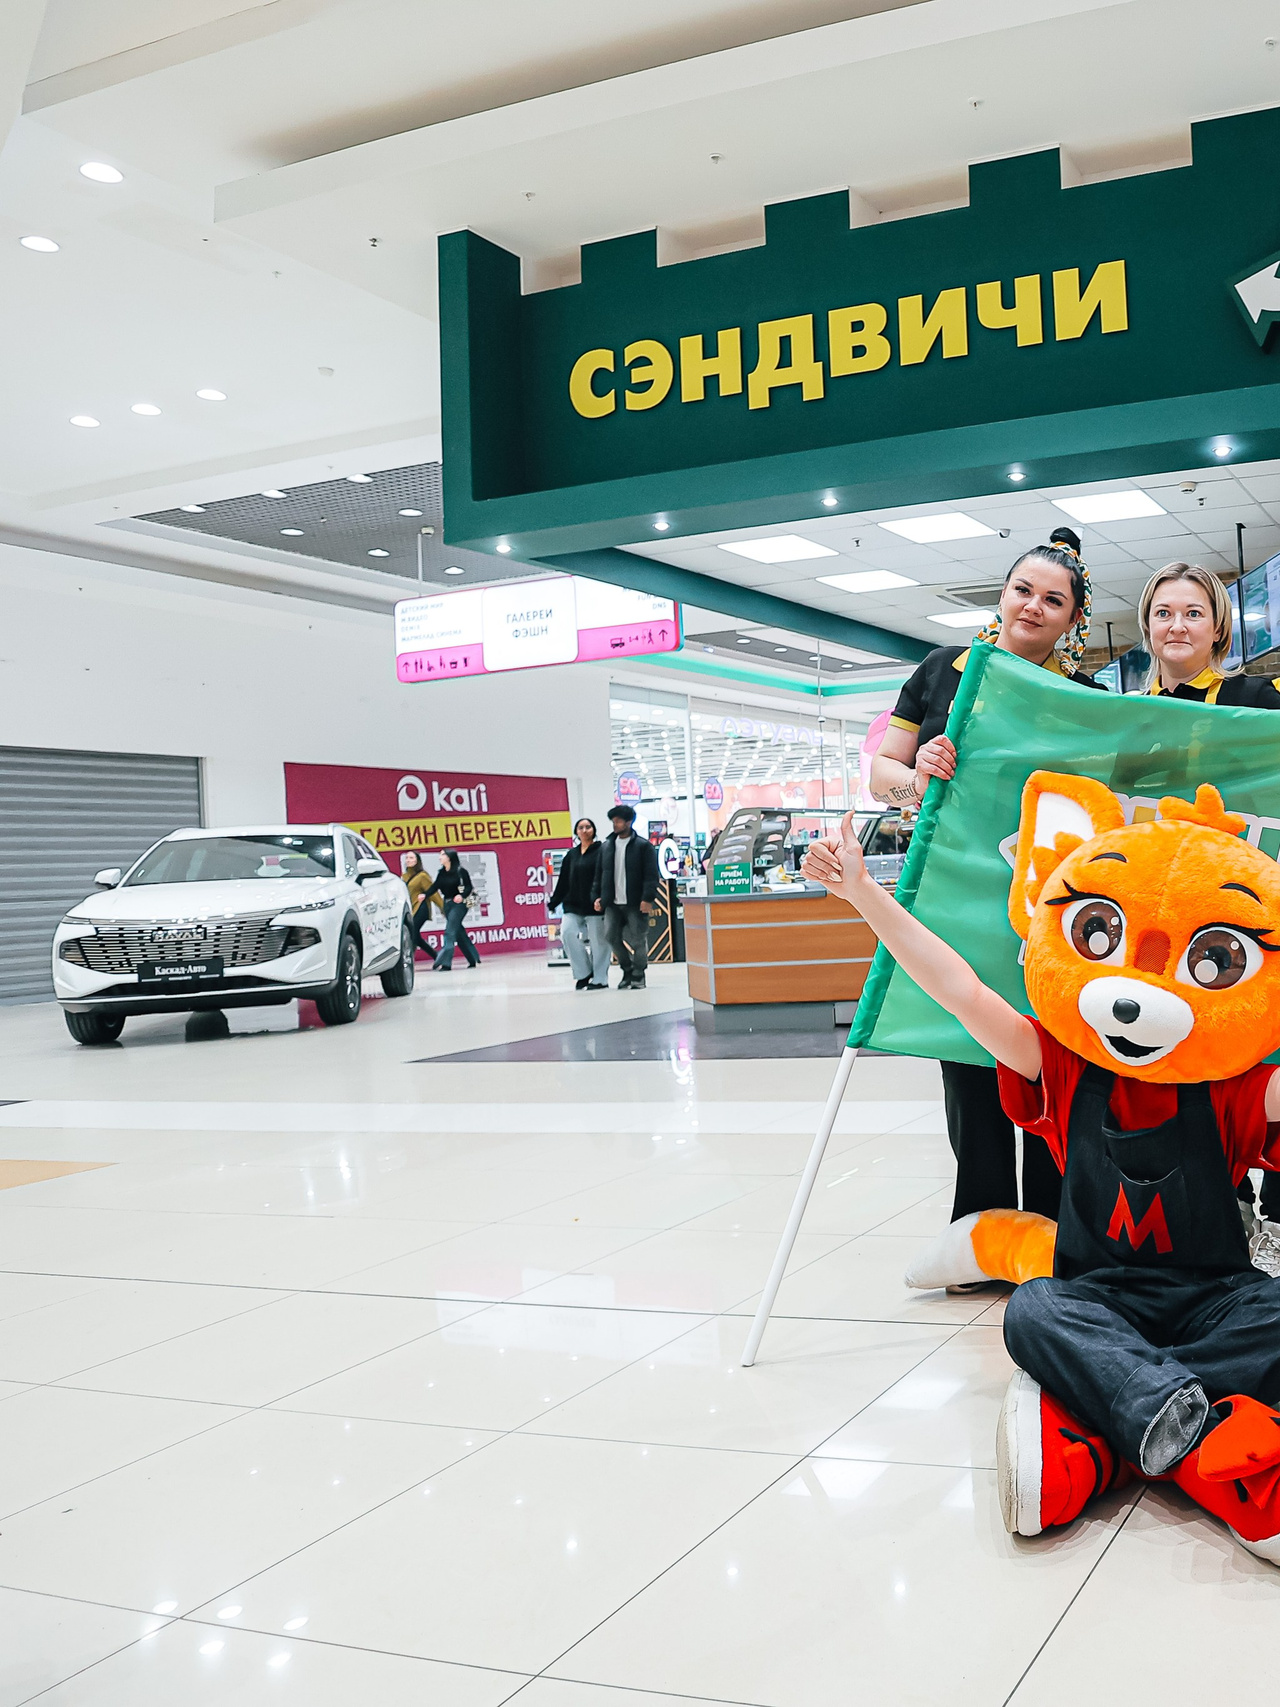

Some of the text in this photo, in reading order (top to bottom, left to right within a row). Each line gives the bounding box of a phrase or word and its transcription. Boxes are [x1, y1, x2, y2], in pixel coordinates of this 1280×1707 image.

[506, 608, 553, 624] ГАЛЕРЕИ
[512, 625, 548, 639] ФЭШН
[432, 780, 489, 812] kari
[444, 818, 552, 843] ПЕРЕЕХАЛ
[526, 866, 548, 887] 20
[725, 878, 750, 886] РАБОТУ
[514, 892, 552, 906] ФЕВРА
[488, 925, 549, 944] МАГАЗИНЕ
